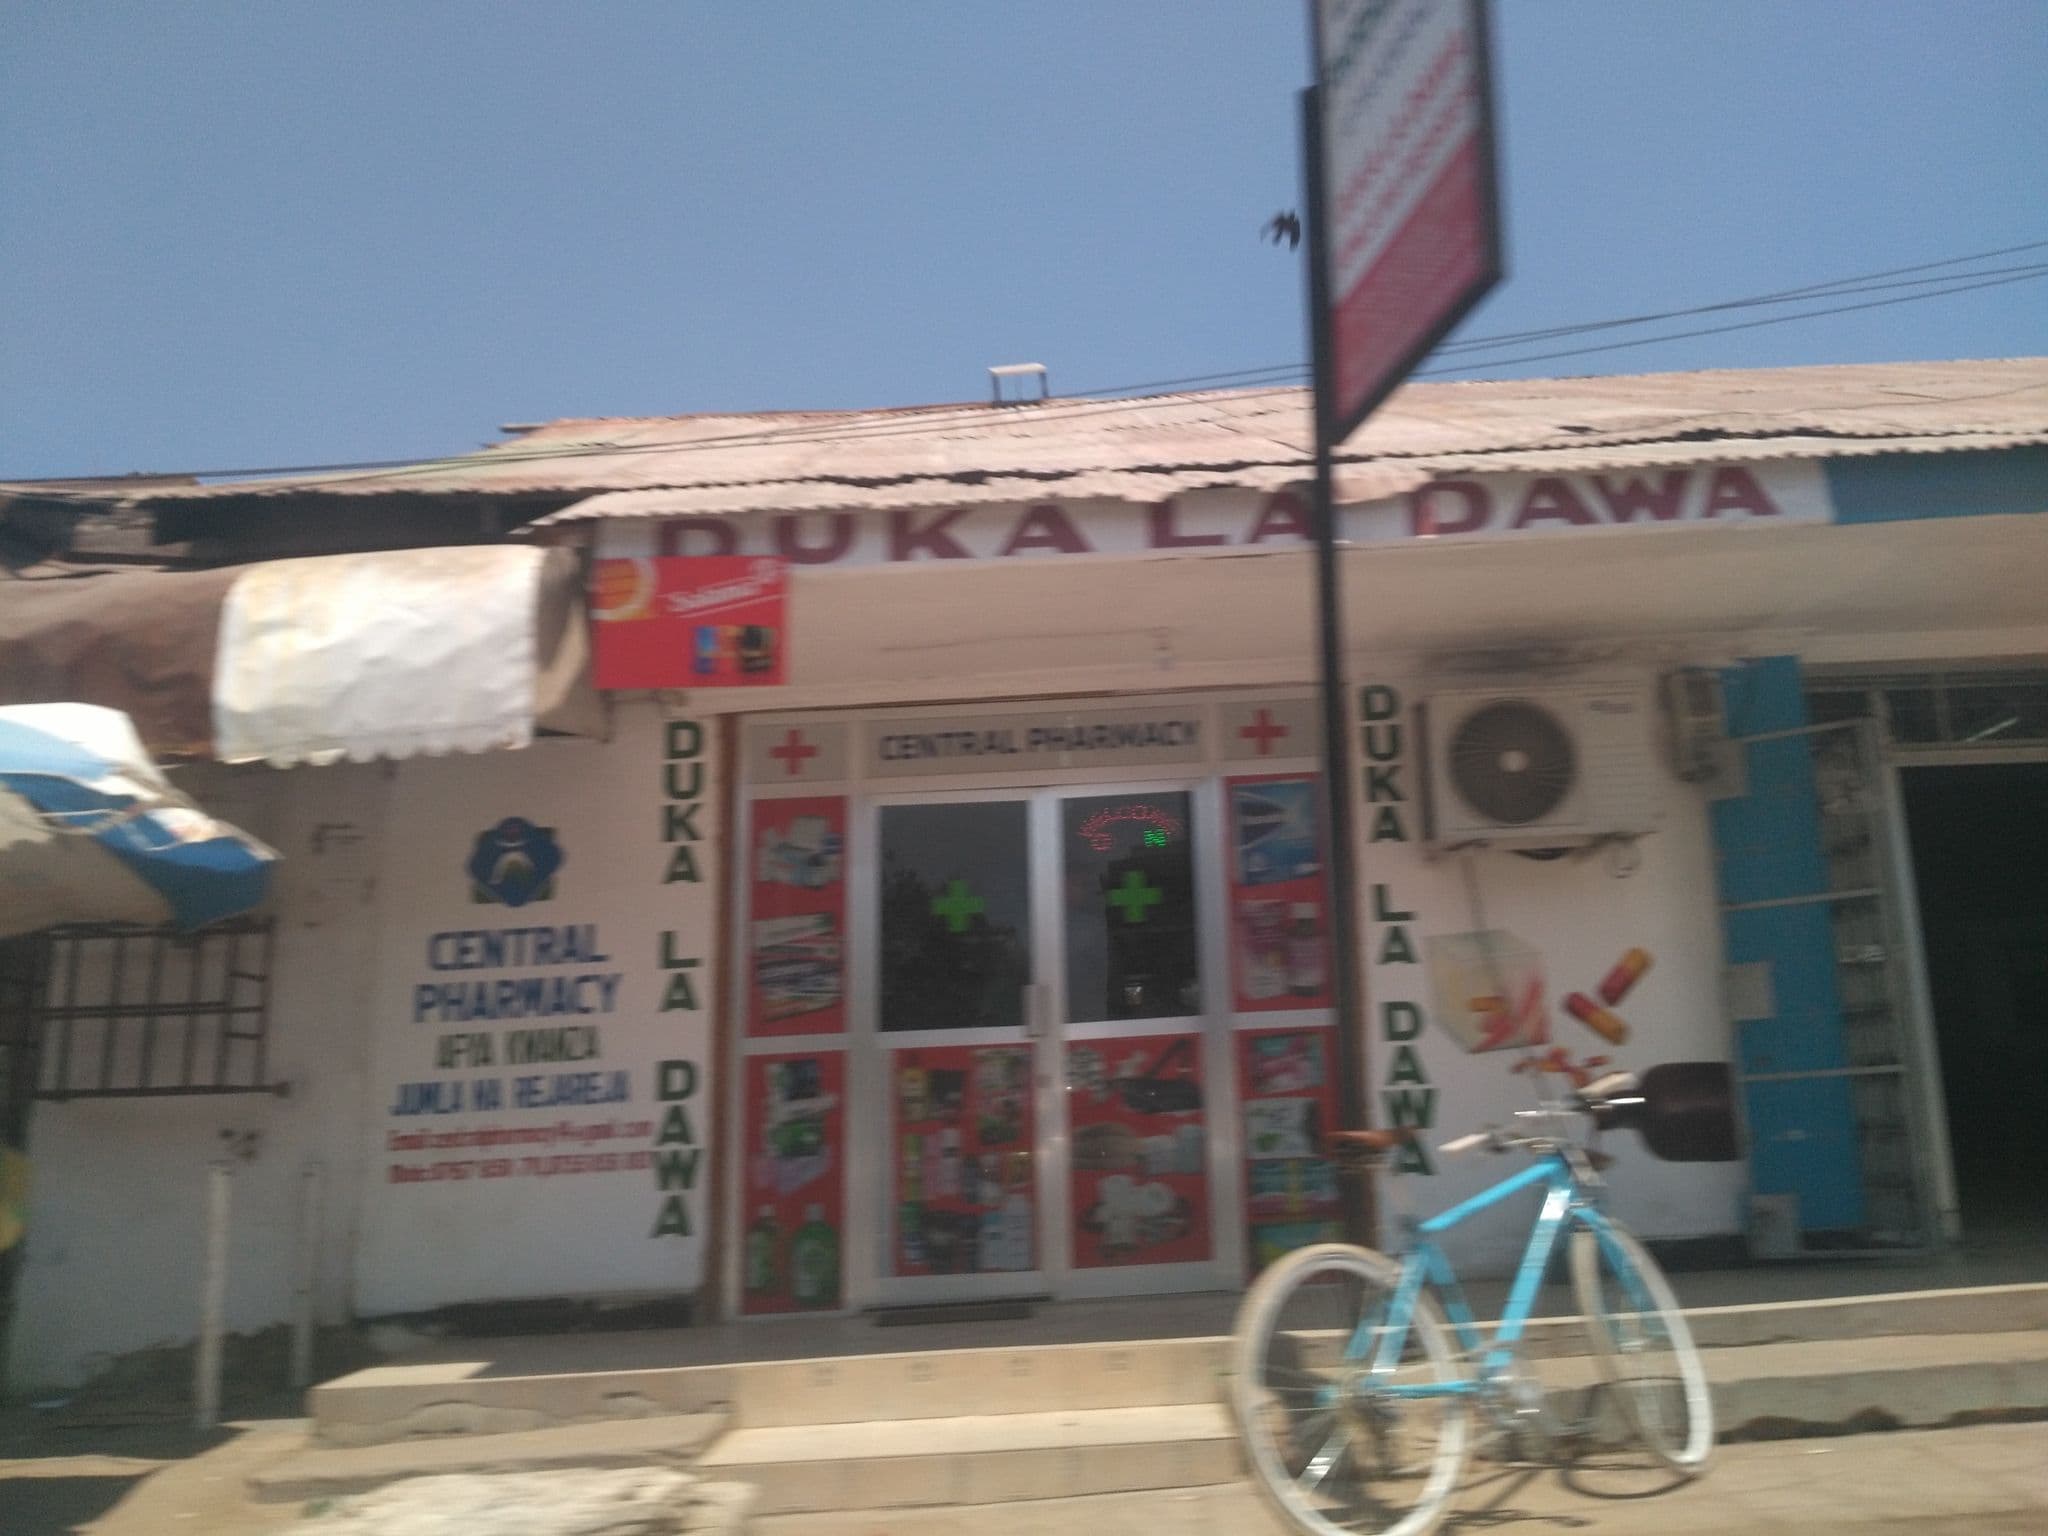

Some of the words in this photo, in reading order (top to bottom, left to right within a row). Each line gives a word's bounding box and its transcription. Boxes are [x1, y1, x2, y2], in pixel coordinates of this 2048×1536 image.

[658, 504, 1094, 565] DUKA
[1150, 481, 1322, 547] LA
[1409, 466, 1781, 537] DAWA
[880, 729, 1018, 760] CENTRAL
[1028, 720, 1198, 750] PHARMACY
[1361, 685, 1408, 843] DUKA
[661, 721, 704, 884] DUKA
[429, 924, 610, 971] CENTRAL
[1371, 884, 1422, 965] LA
[413, 973, 622, 1023] PHARMACY
[659, 931, 702, 1012] LA
[1380, 1001, 1440, 1177] DAWA
[648, 1060, 702, 1239] DAWA
